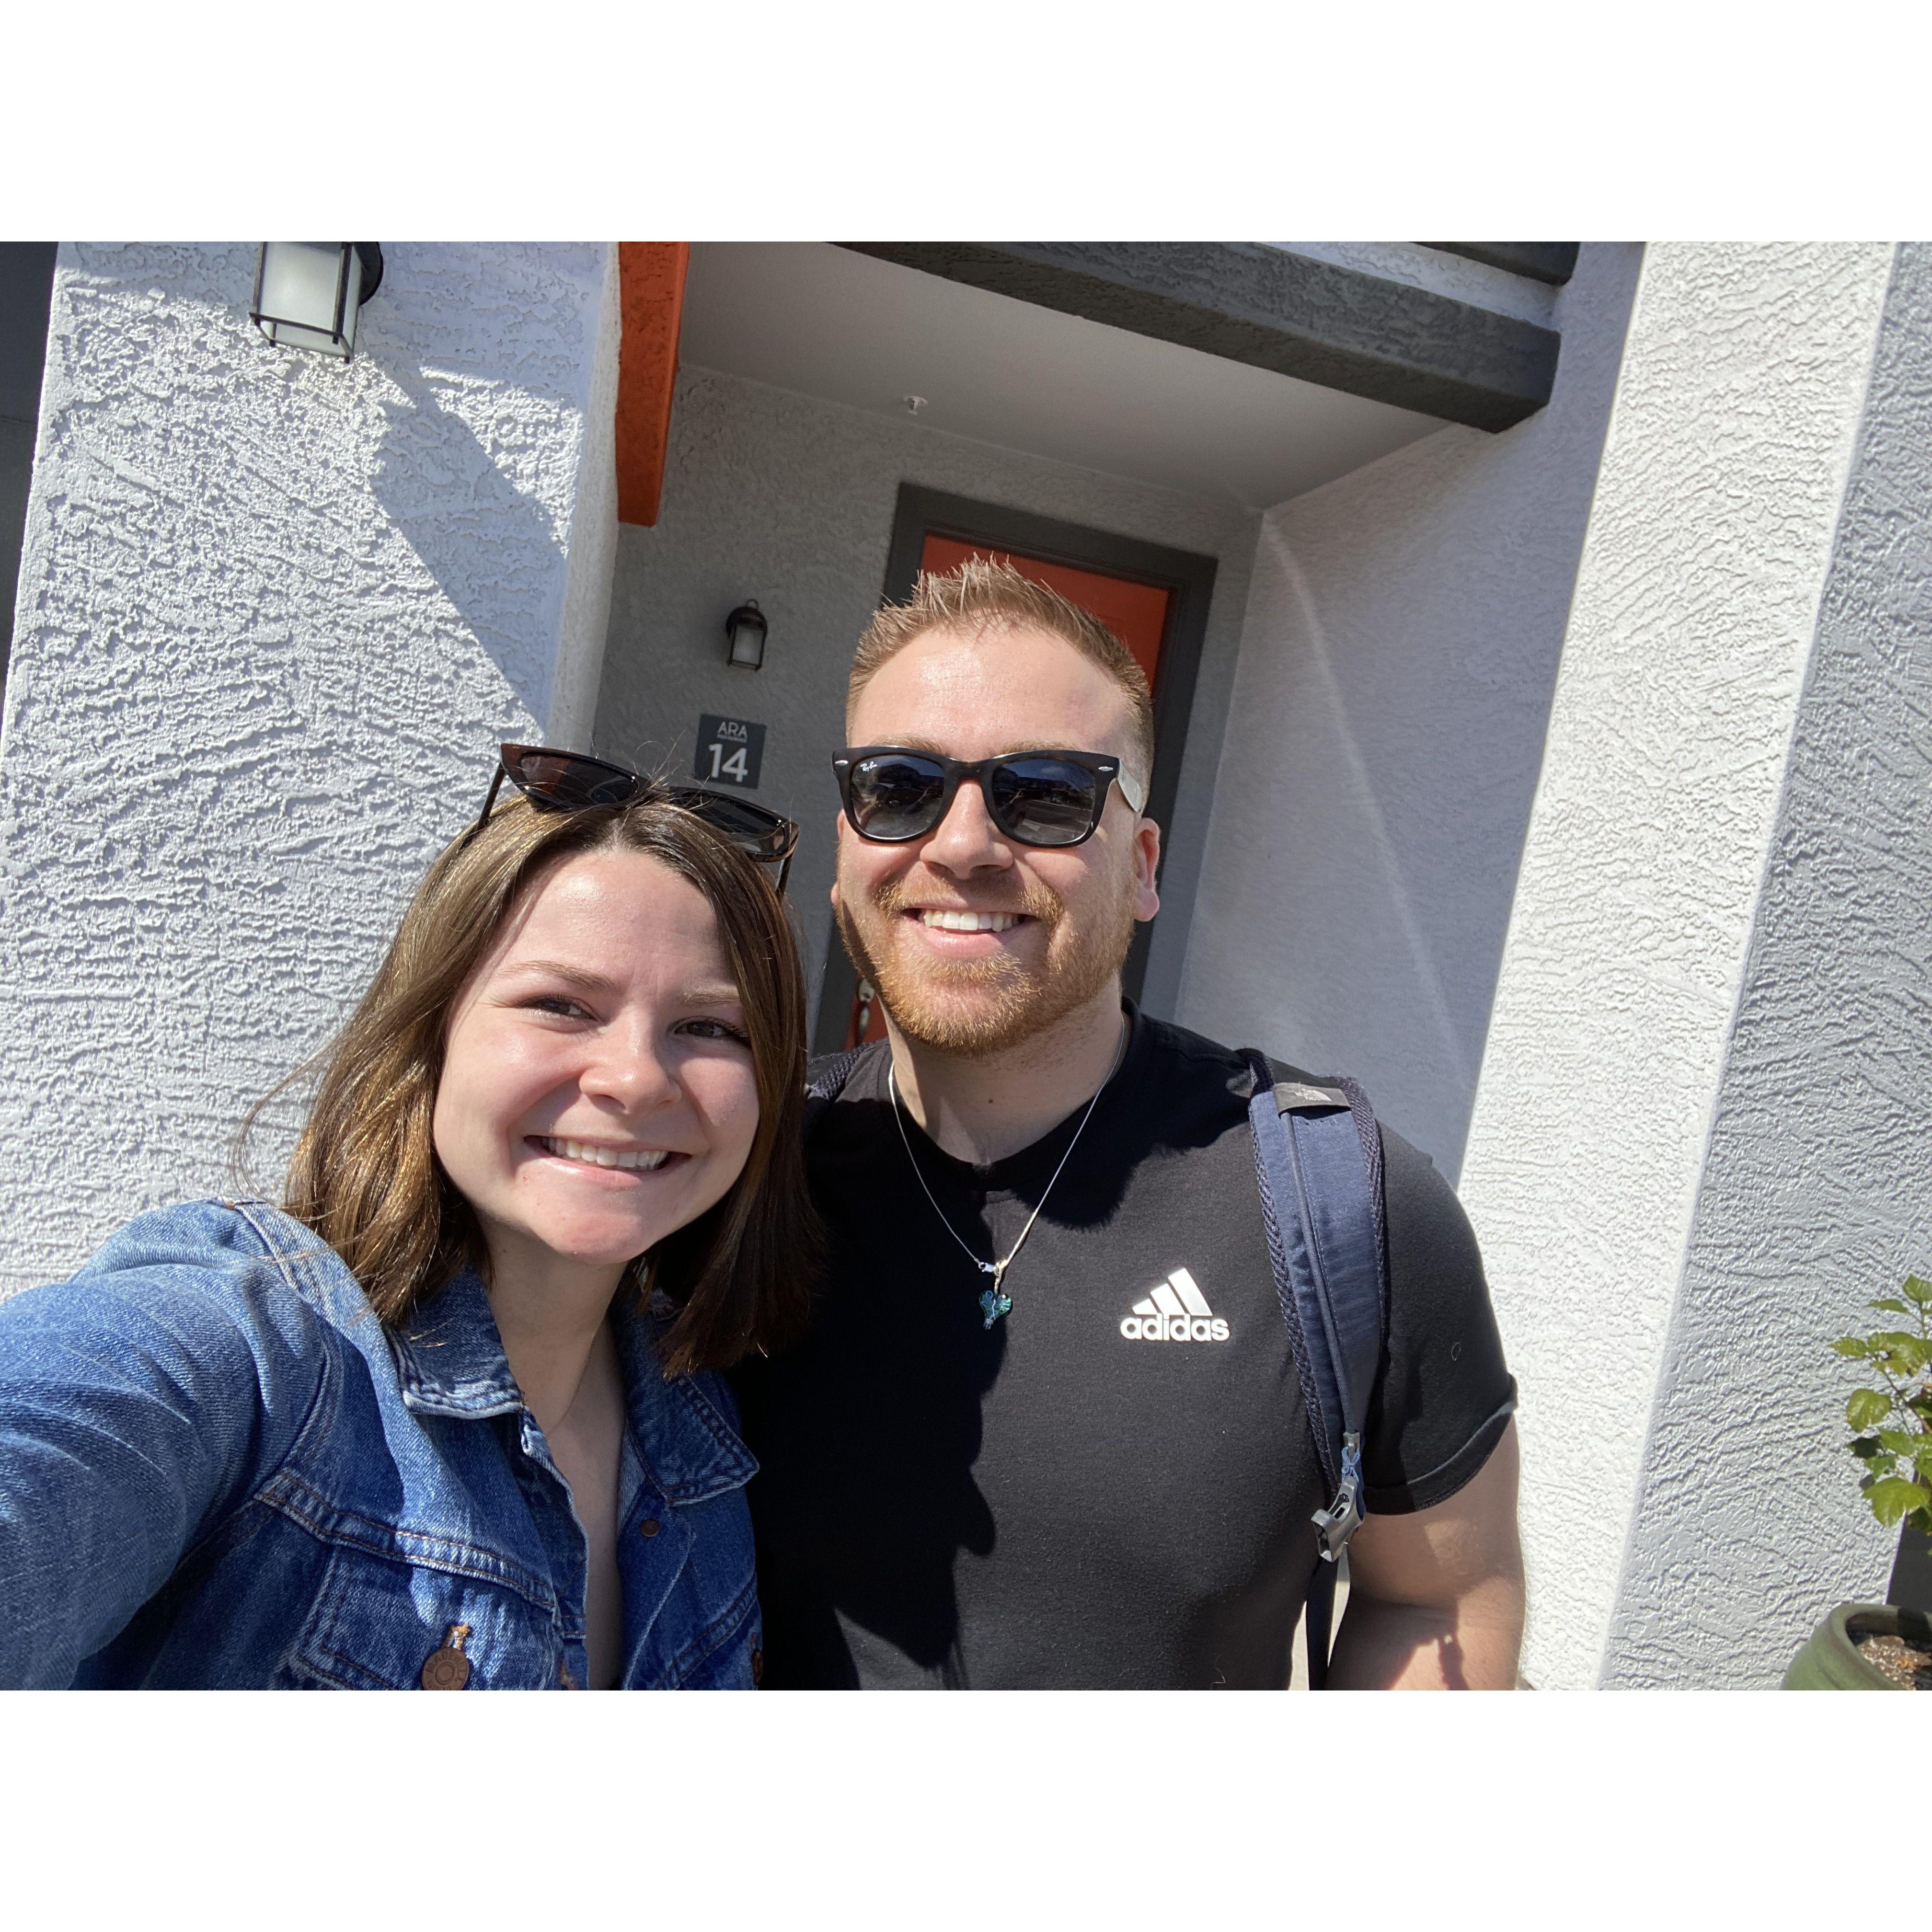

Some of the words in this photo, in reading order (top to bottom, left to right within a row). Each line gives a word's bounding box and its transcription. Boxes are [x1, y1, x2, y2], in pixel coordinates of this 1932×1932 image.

[717, 721, 748, 740] ARA
[709, 743, 748, 782] 14
[1120, 1313, 1230, 1341] adidas
